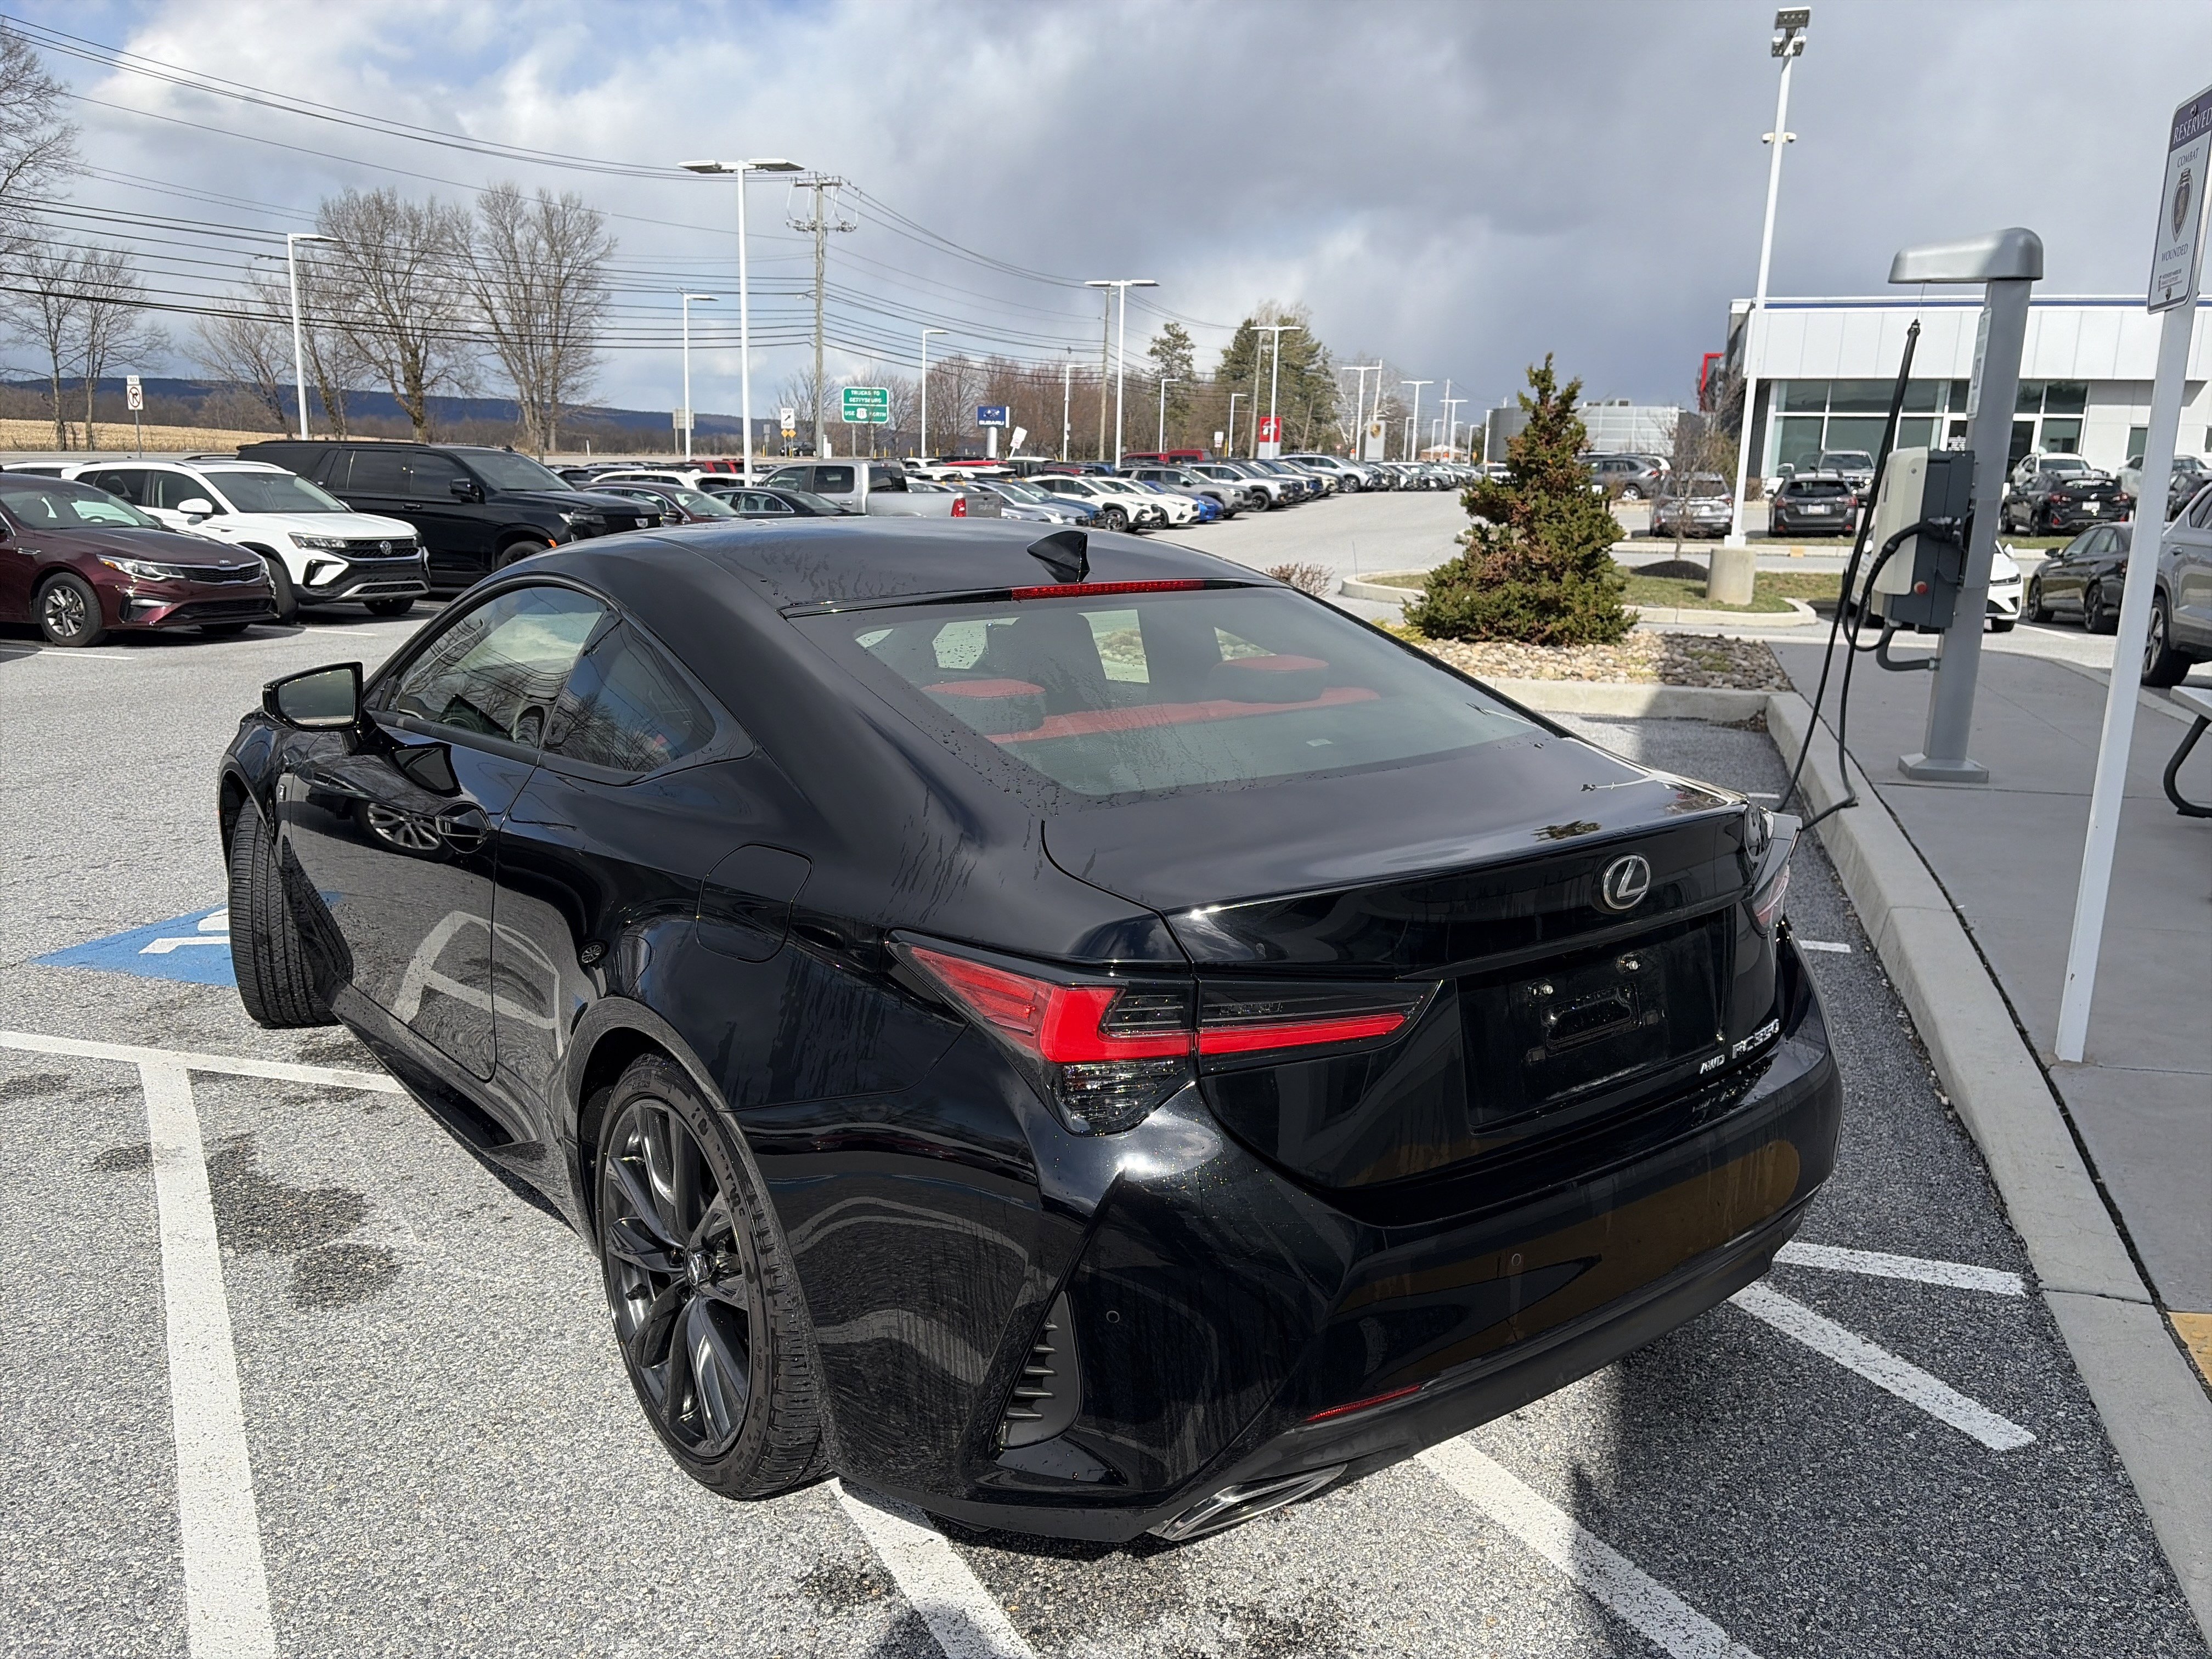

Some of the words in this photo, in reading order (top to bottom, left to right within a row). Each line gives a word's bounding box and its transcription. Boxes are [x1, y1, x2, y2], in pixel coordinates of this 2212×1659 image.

[2173, 107, 2212, 144] RESERVED
[2177, 147, 2199, 167] COMBAT
[2162, 243, 2188, 262] WOUNDED
[1700, 1054, 1725, 1074] AWD
